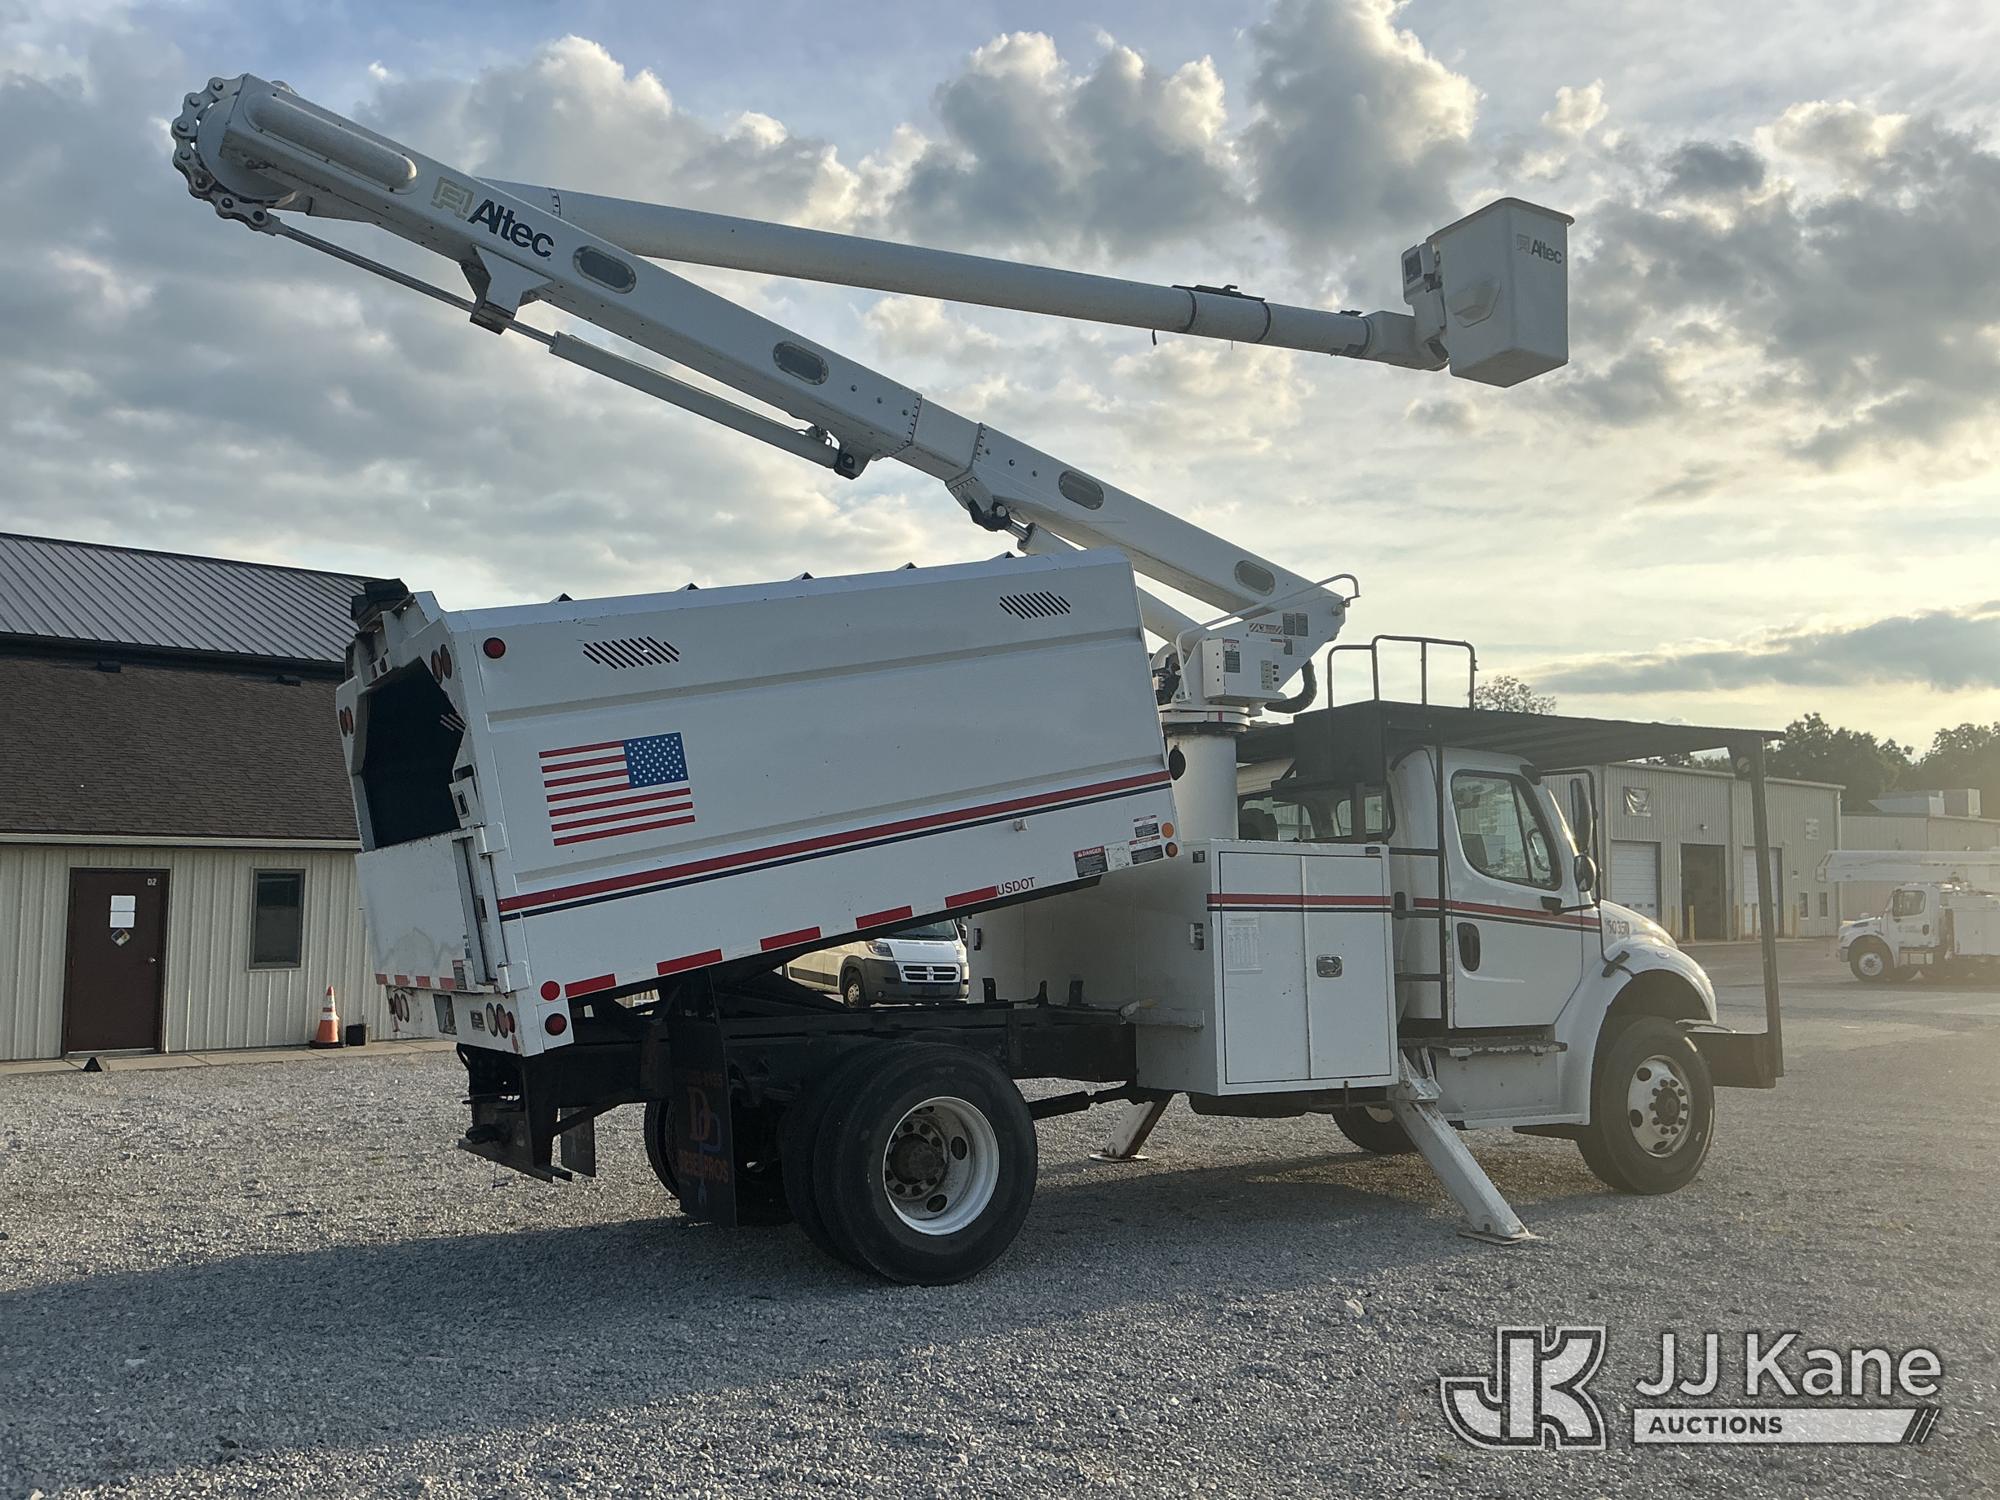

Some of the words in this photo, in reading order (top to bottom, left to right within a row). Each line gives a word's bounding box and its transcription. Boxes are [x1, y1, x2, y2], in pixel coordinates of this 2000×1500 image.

[466, 198, 555, 258] Altec
[1530, 239, 1562, 265] Altec
[997, 877, 1035, 895] USDOT
